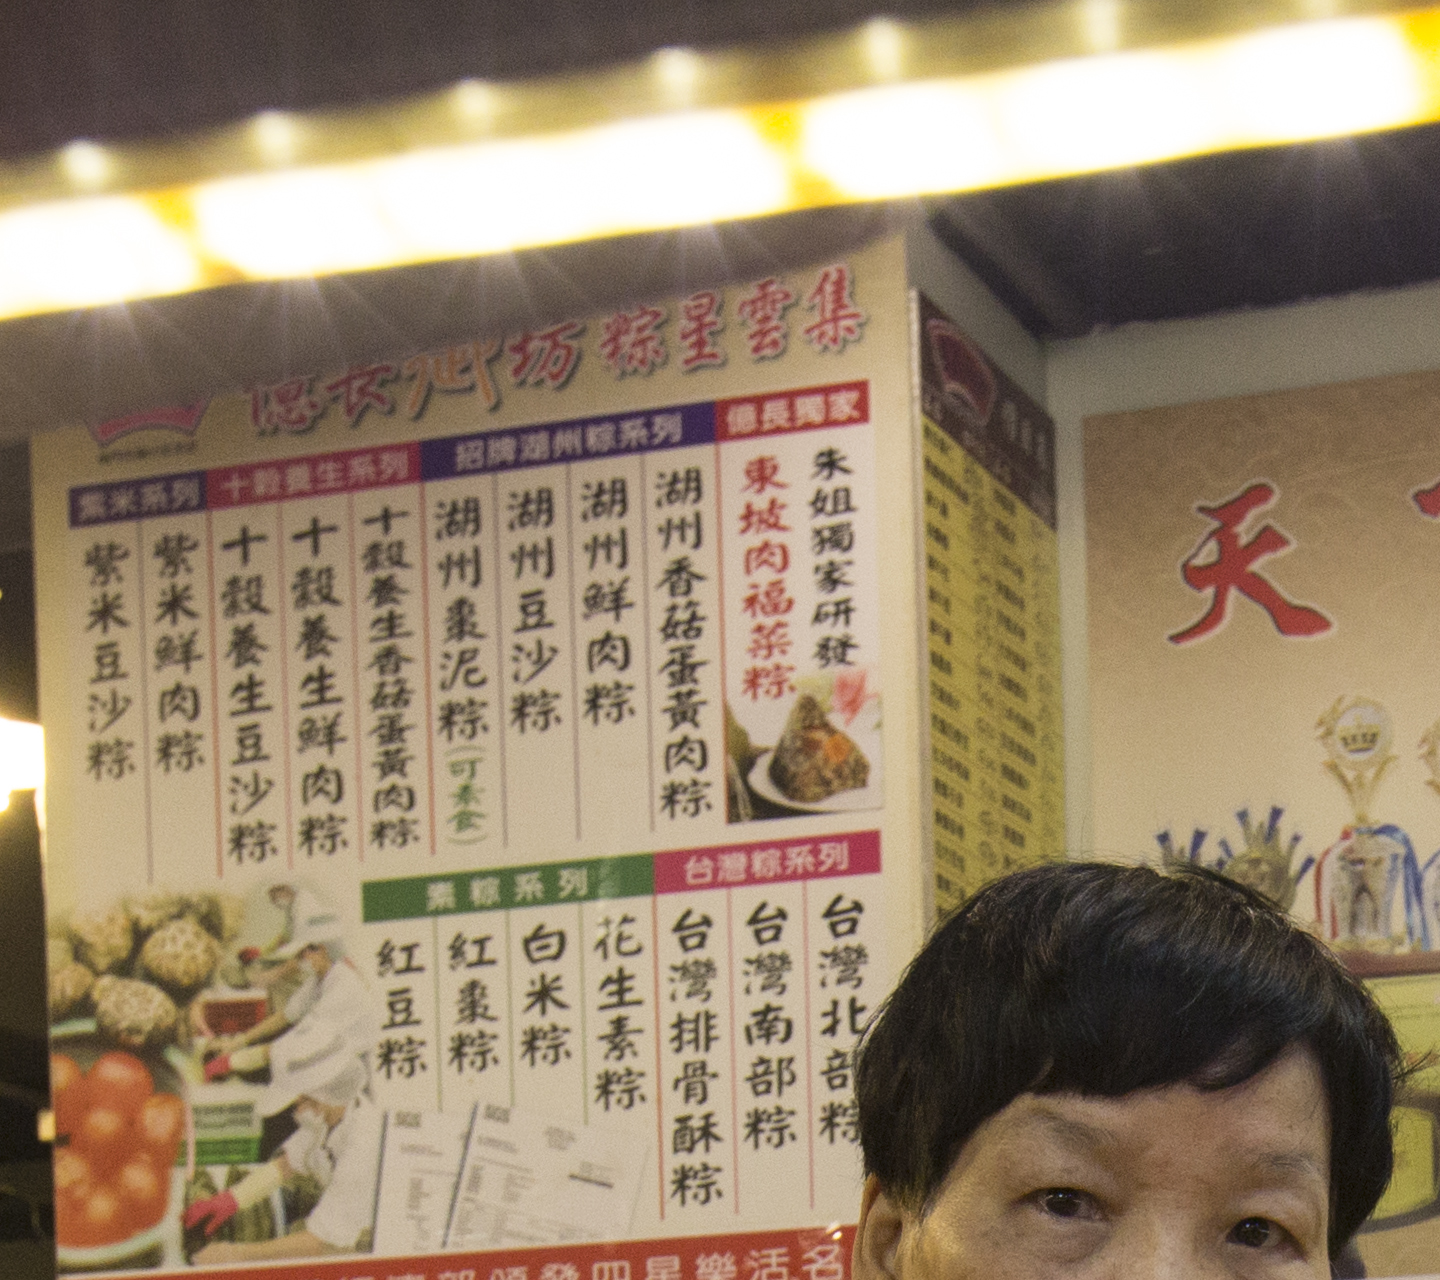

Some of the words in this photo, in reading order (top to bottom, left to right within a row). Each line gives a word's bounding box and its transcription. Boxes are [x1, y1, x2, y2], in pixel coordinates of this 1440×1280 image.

[455, 412, 684, 473] 招牌湖州粽系列
[725, 388, 863, 437] 億長獨家
[84, 541, 136, 782] 紫米豆沙粽
[153, 532, 205, 775] 紫米鮮肉粽
[433, 497, 489, 743] 湖州棗泥粽
[507, 487, 561, 734] 湖州豆沙粽
[580, 478, 636, 727] 湖州鮮肉粽
[656, 467, 714, 821] 湖州香菇蛋黃肉粽
[738, 455, 798, 703] 東坡肉福菜粽
[808, 446, 859, 670] 朱姐獨家研發
[426, 867, 588, 912] 素粽系列
[684, 840, 851, 887] 台灣粽系列
[375, 938, 427, 1081] 紅豆粽
[447, 931, 500, 1076] 紅棗粽
[521, 923, 573, 1069] 白米粽
[592, 912, 648, 1113] 花生素粽
[667, 907, 724, 1208] 台灣排骨酥粽
[741, 900, 797, 1151] 台灣南部粽
